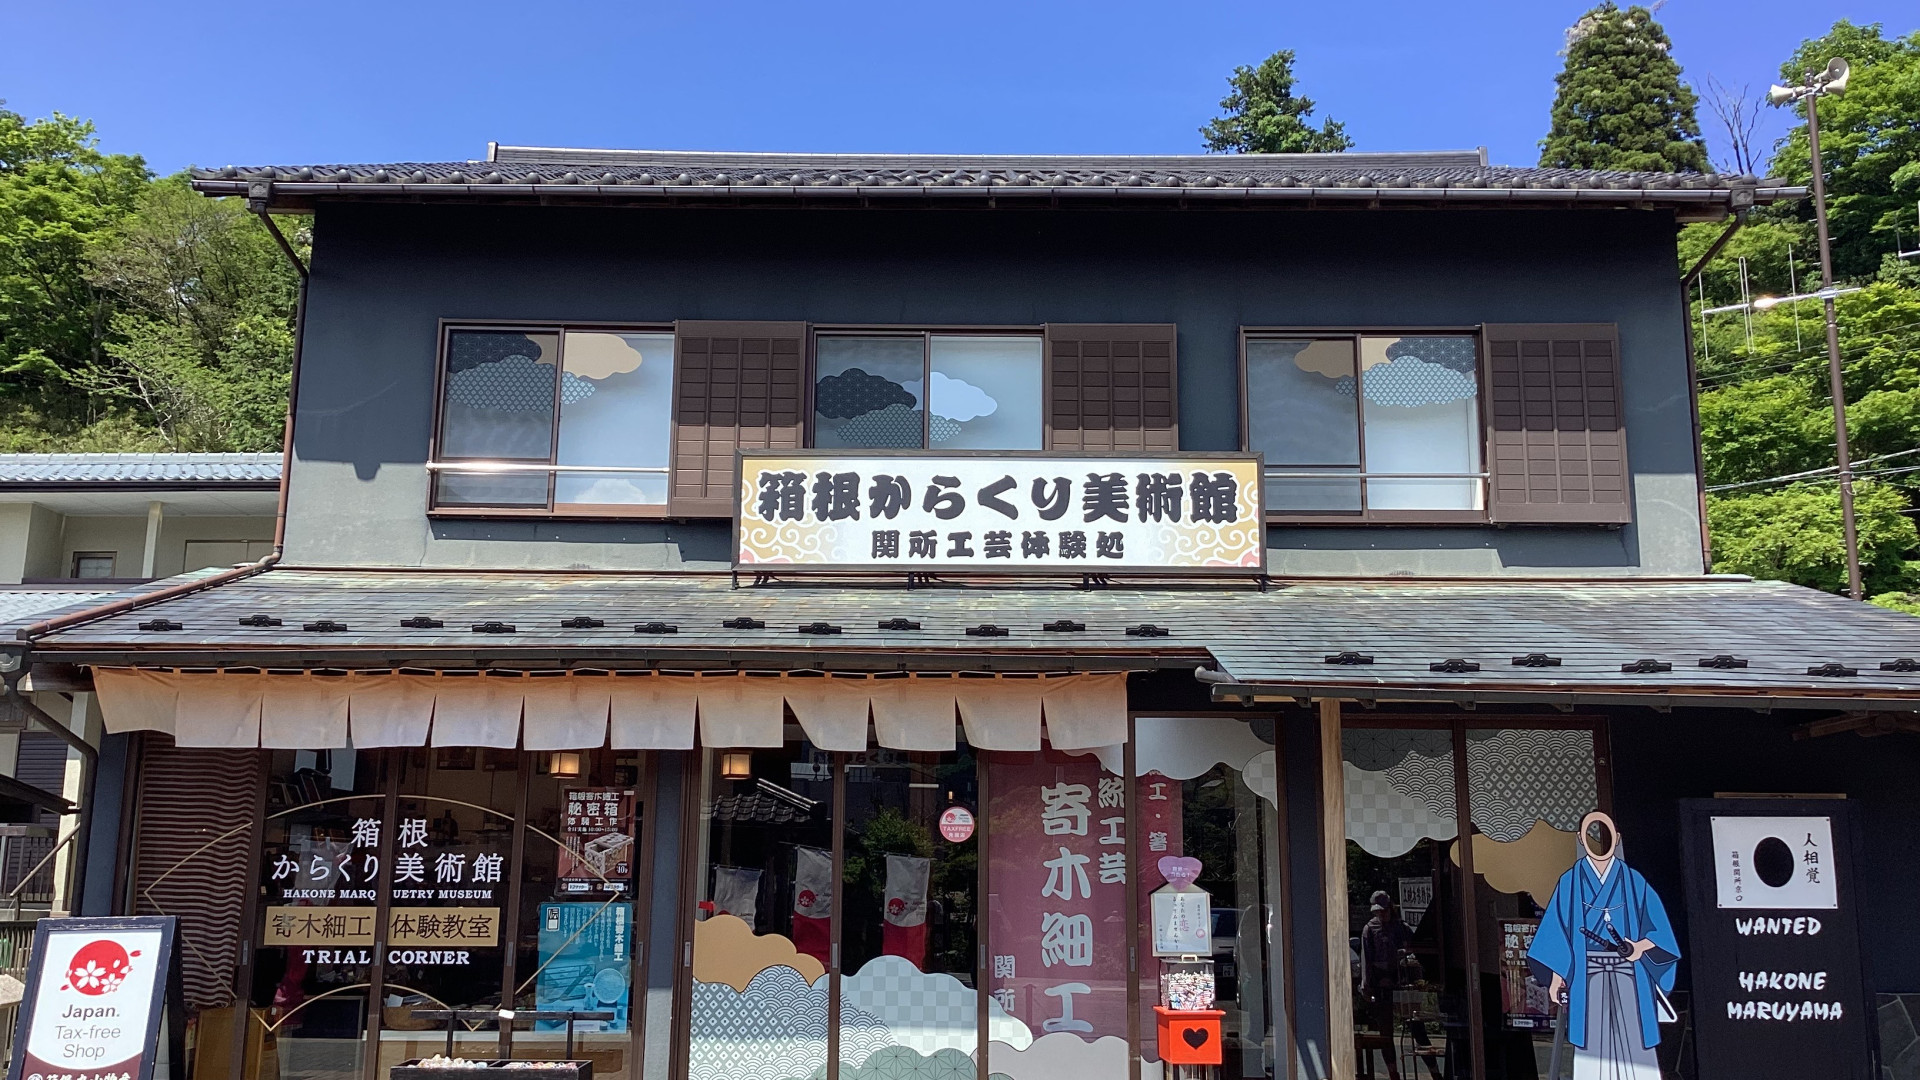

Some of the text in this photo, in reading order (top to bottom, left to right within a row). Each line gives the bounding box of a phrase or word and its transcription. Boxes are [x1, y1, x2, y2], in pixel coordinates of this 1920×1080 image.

[758, 472, 1239, 524] 箱根からくり美術館
[871, 530, 1124, 559] 関所工芸体験処
[568, 802, 618, 816] 秘密箱
[1149, 770, 1168, 852] 工・箸
[351, 818, 428, 848] 箱根
[1098, 766, 1127, 884] 統工芸
[271, 853, 504, 883] からくり美術館
[283, 889, 335, 899] HAKONE
[438, 889, 492, 899] MUSEUM
[1041, 783, 1094, 1032] 寄木細工
[272, 914, 493, 939] 寄木細工 体験教室
[1735, 917, 1821, 935] WANTED
[302, 950, 470, 965] TRIAL CORNER
[1738, 971, 1827, 992] HAKONE
[62, 1004, 120, 1021] Japan.
[1727, 1001, 1843, 1022] MARUYAMA
[55, 1025, 121, 1040] Tax-free
[63, 1043, 105, 1060] Shop
